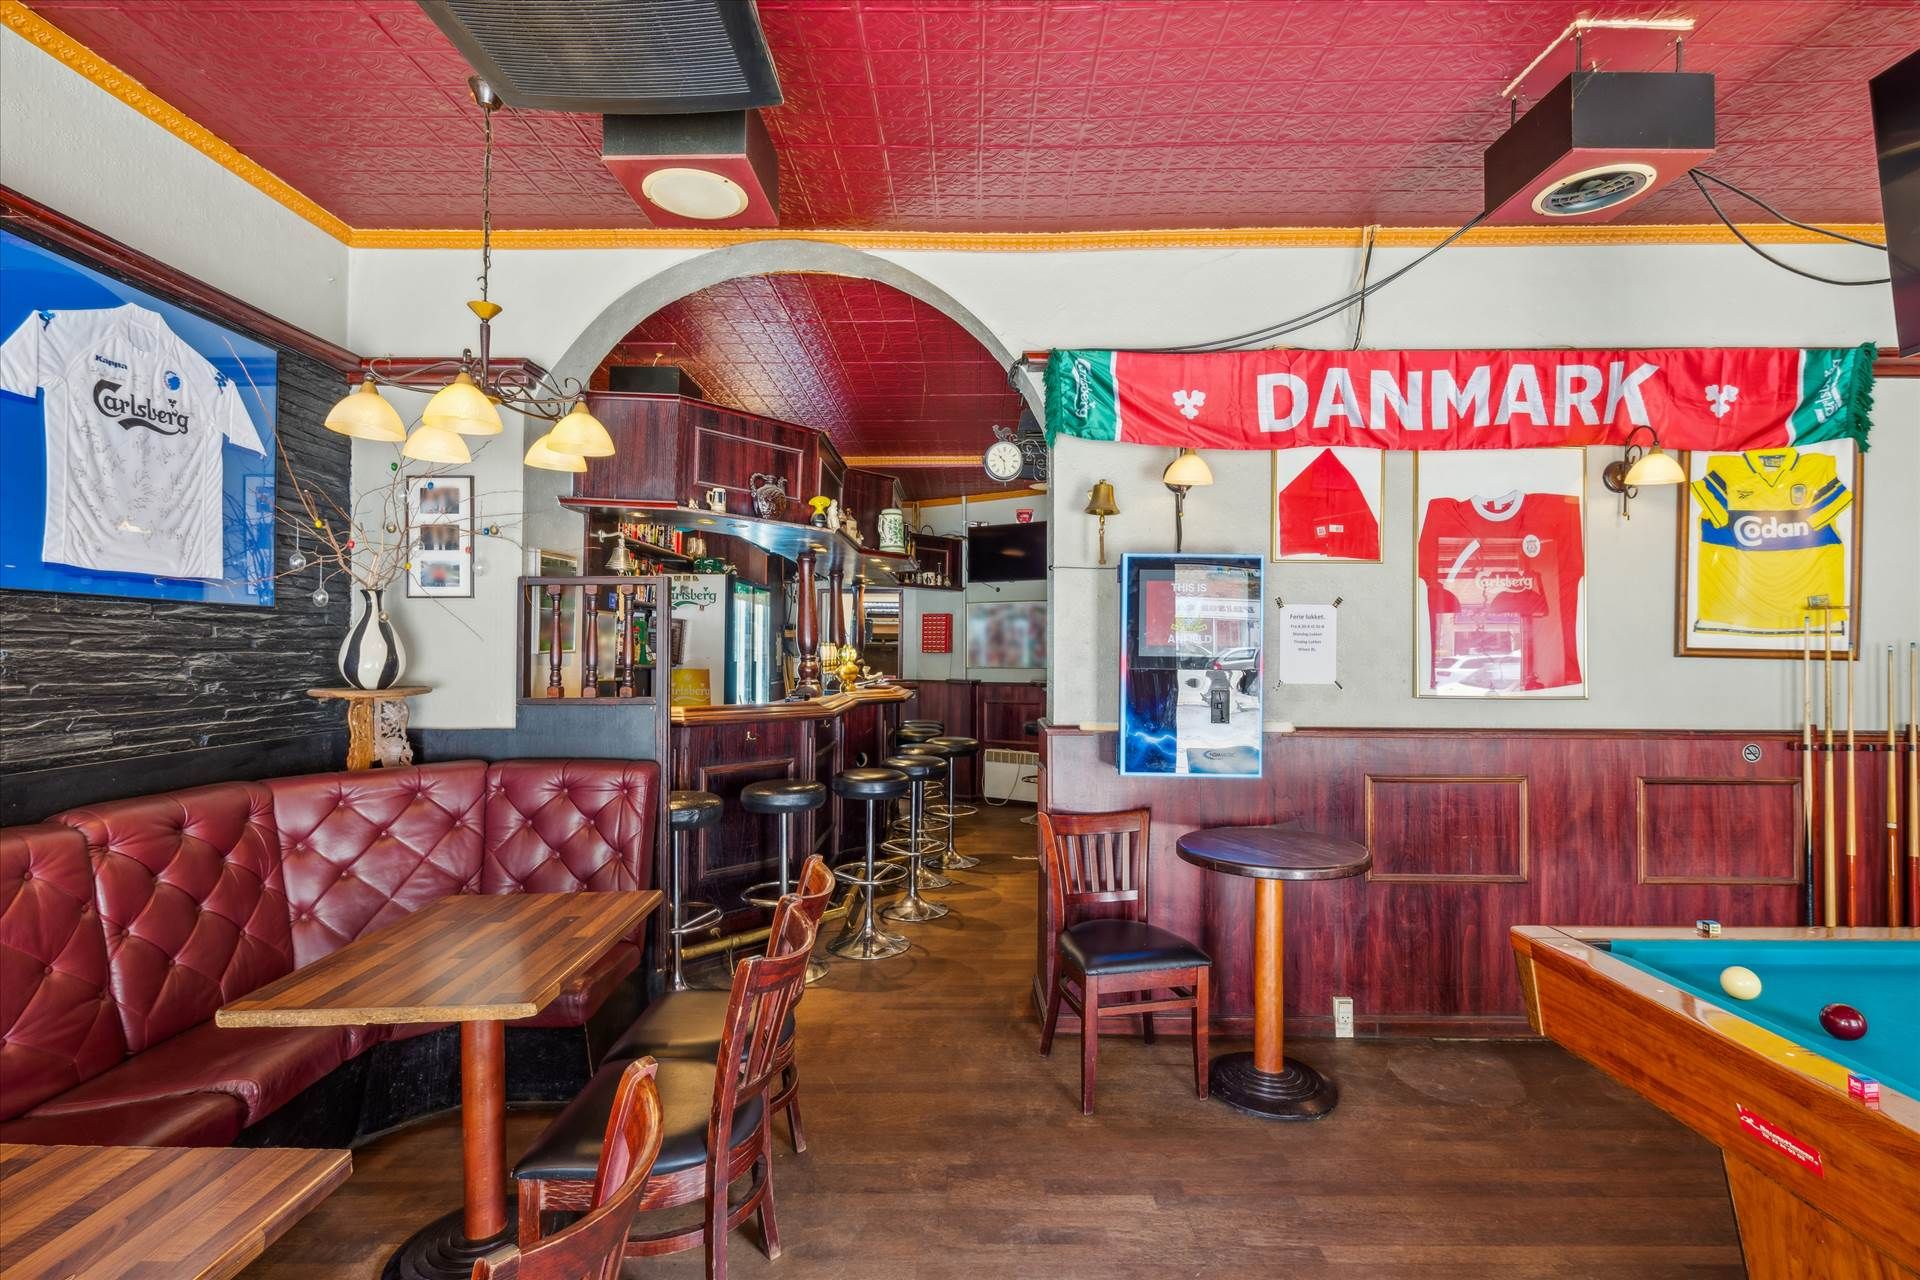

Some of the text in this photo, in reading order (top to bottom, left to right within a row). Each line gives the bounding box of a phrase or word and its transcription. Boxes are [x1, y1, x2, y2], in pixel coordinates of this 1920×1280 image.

[95, 354, 128, 370] Kappa
[93, 379, 189, 435] Carlsberg
[1256, 361, 1660, 433] DANMARK
[1733, 515, 1809, 547] Codan
[1171, 583, 1208, 593] THIS IS
[1475, 567, 1533, 593] Carlsberg
